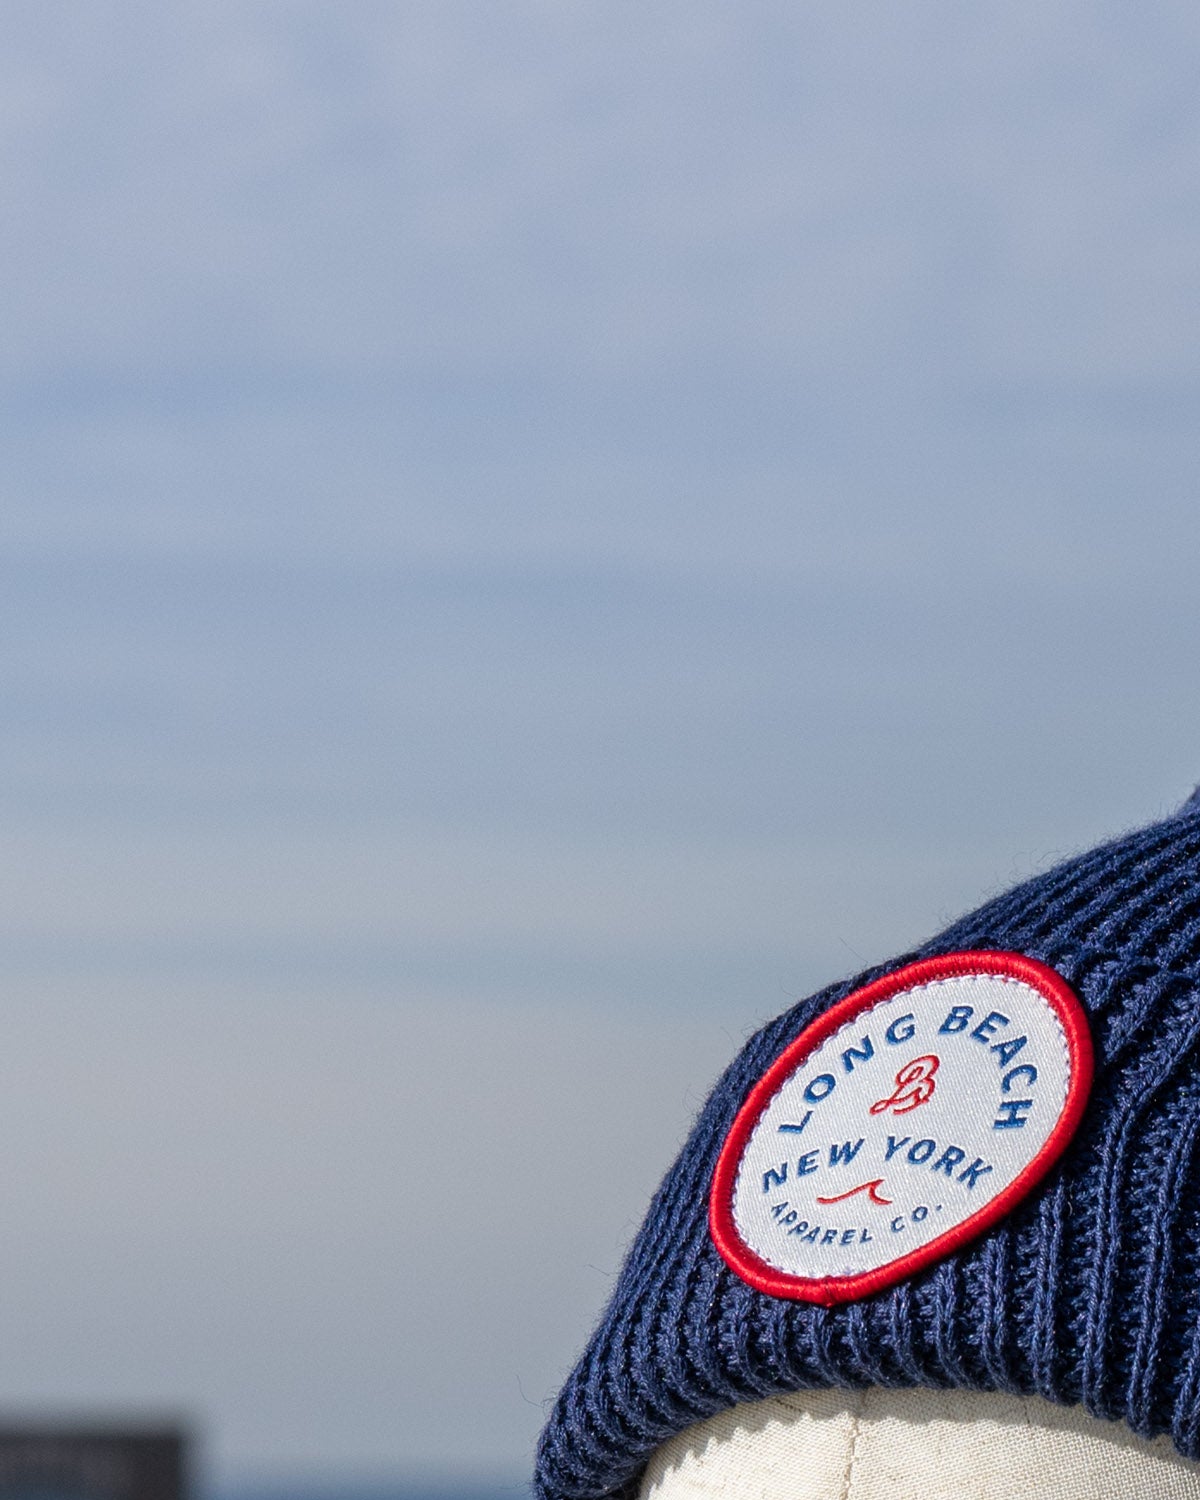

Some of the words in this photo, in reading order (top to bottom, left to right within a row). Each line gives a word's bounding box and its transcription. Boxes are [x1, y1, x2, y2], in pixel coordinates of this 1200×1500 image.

[778, 1013, 916, 1135] LONG
[937, 1005, 1038, 1131] BEACH
[762, 1138, 865, 1193] NEW
[884, 1135, 994, 1190] YORK
[771, 1200, 873, 1246] APPAREL
